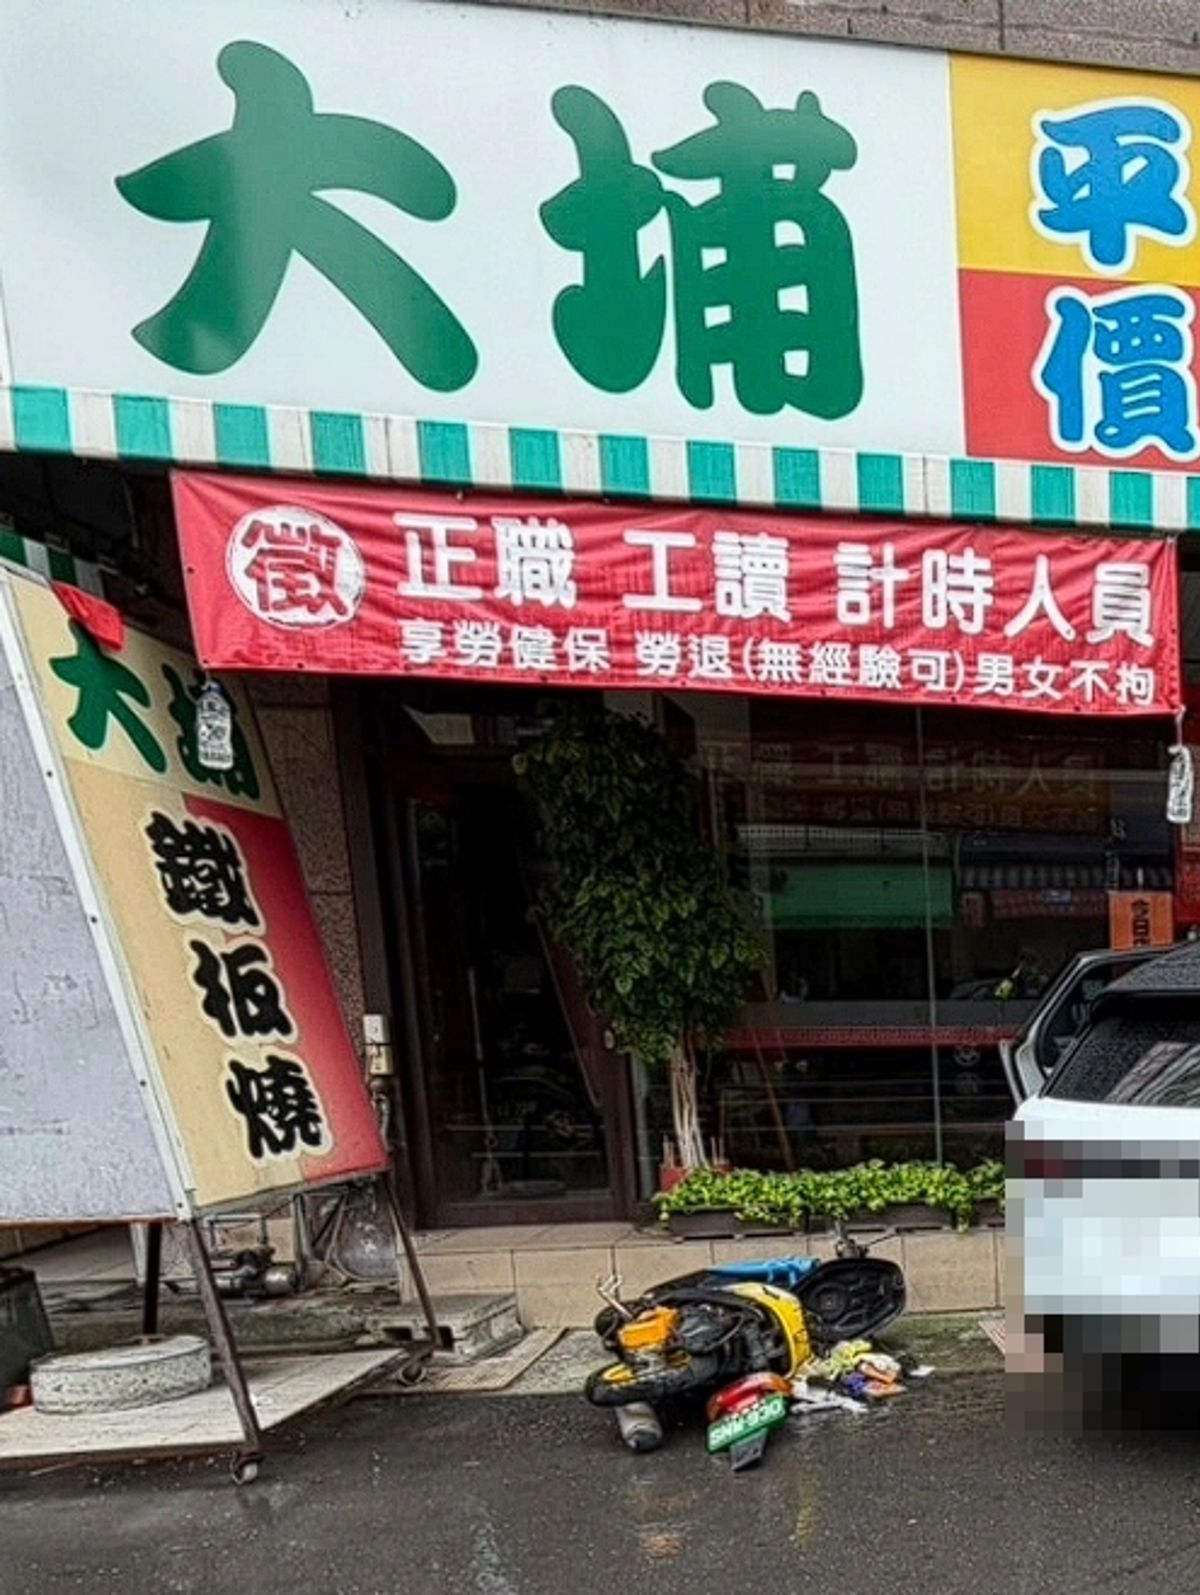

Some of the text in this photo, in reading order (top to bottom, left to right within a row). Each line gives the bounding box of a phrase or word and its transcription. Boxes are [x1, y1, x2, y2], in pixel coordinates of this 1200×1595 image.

[114, 40, 864, 420] 大埔
[238, 516, 348, 616] 徵
[393, 511, 1154, 647] 正職 工讀 計時人員
[400, 618, 610, 674] 享勞健保
[144, 809, 327, 1160] 鐵板燒
